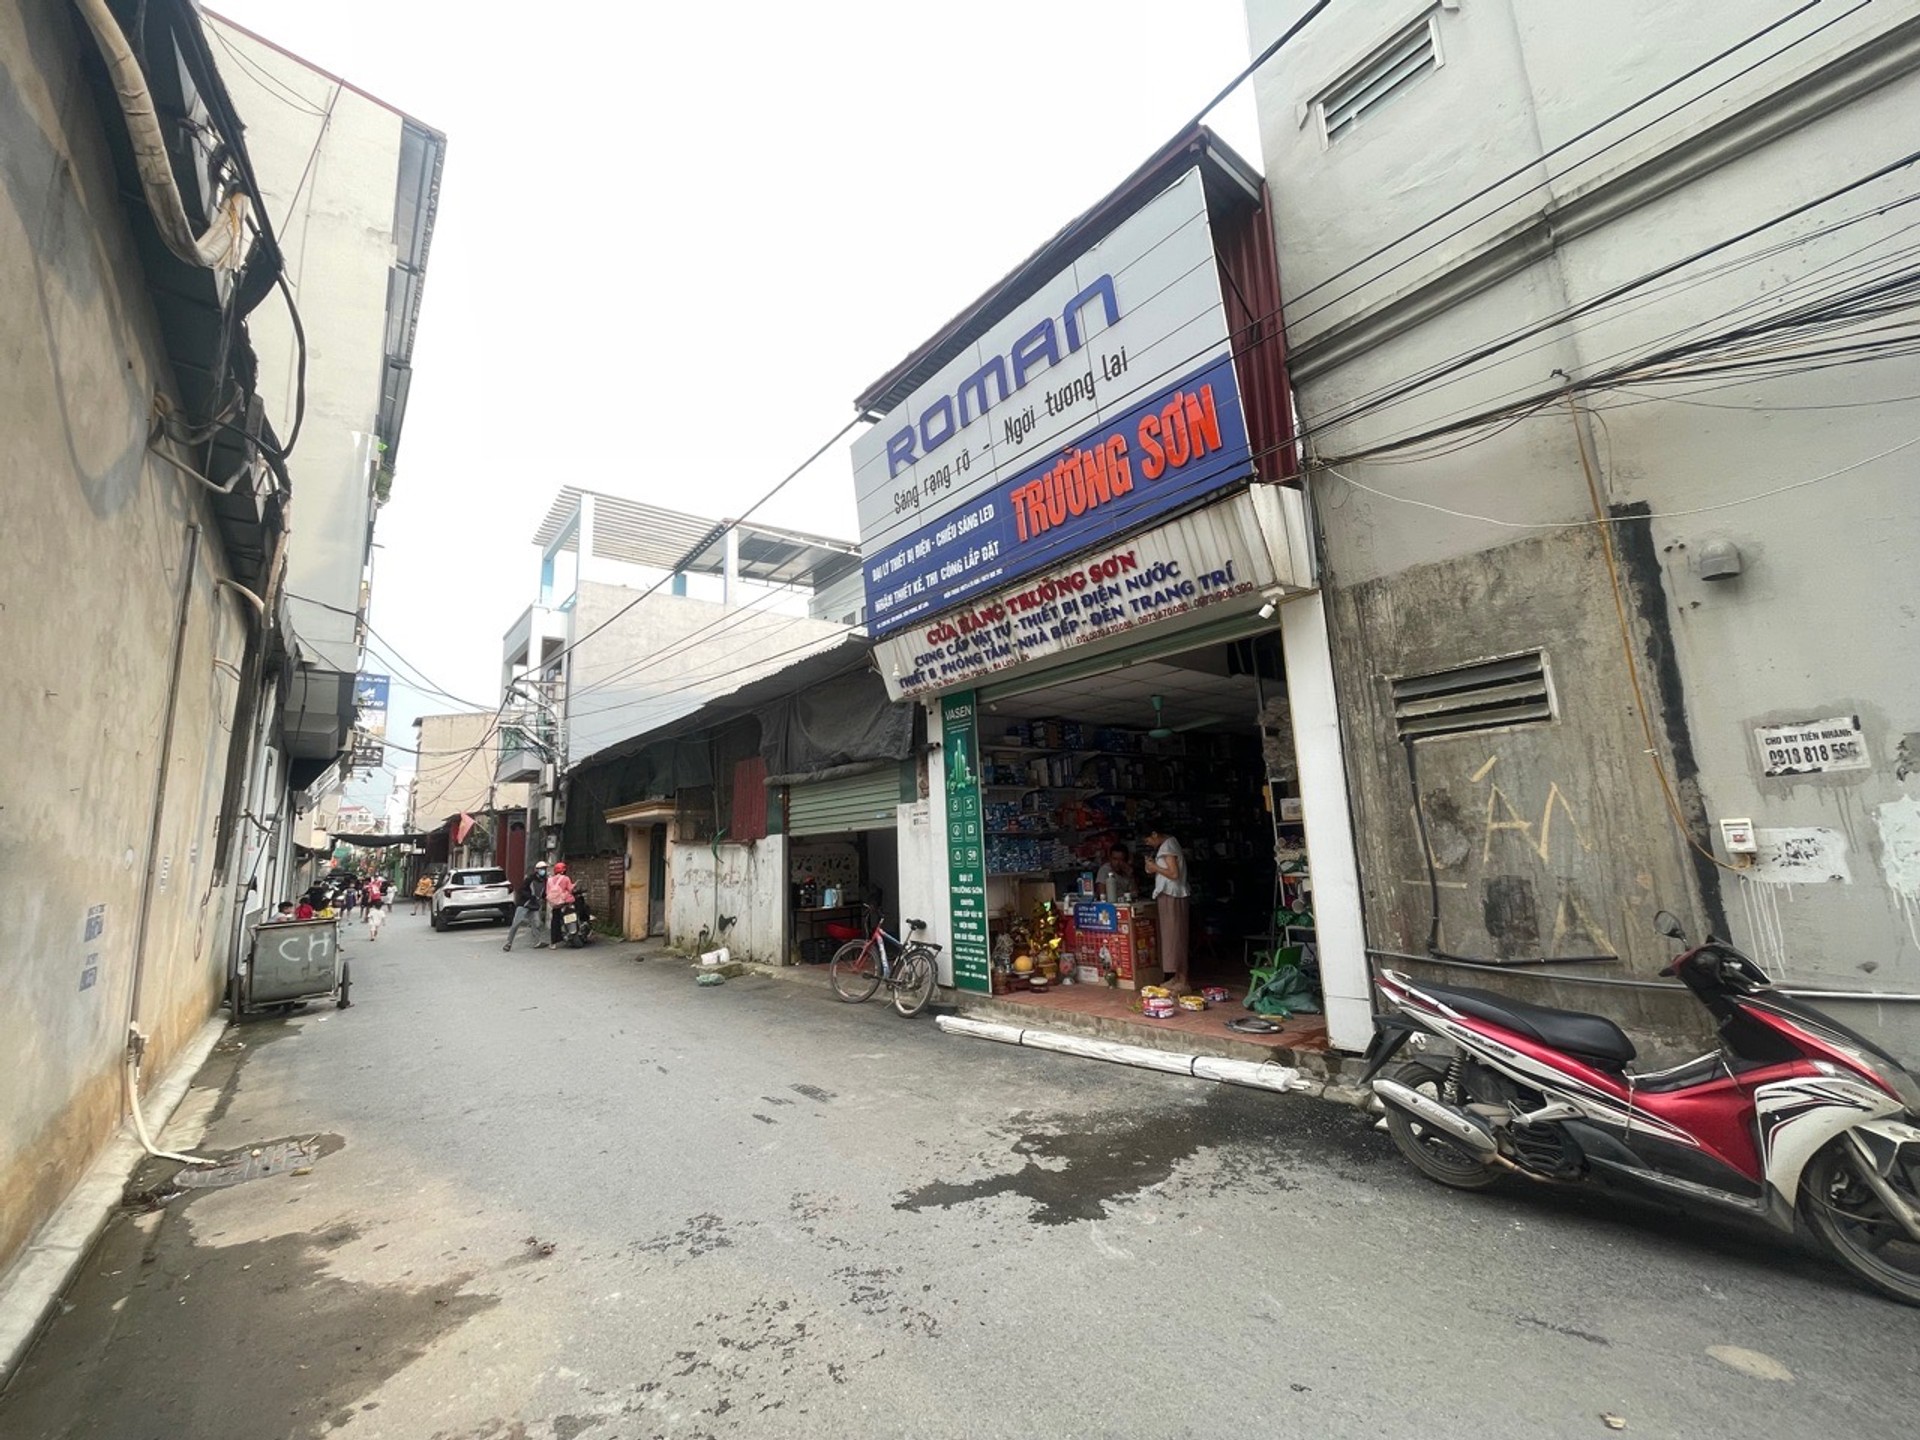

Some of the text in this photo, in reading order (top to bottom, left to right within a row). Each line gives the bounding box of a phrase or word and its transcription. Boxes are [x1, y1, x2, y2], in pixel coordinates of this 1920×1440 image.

[923, 465, 951, 496] rạng
[1004, 405, 1036, 445] Ngời
[1045, 370, 1097, 417] tương
[1102, 345, 1129, 382] lai
[1010, 383, 1223, 542] TRƯỜNG SƠN
[890, 549, 905, 573] THIẾT
[907, 547, 915, 564] BỊ
[915, 538, 931, 558] ĐIỆN
[936, 521, 957, 547] CHIẾU
[957, 511, 979, 536] SÁNG
[979, 503, 995, 525] LED
[894, 581, 912, 604] THIẾT
[925, 571, 939, 588] THI
[940, 560, 963, 580] CÔNG
[964, 547, 980, 570] LẮP
[981, 540, 999, 561] ĐẶT
[900, 667, 927, 688] THIẾT
[941, 652, 983, 675] PHÒNG
[1017, 630, 1049, 651] NHÀ
[1050, 616, 1079, 640] BẾP
[1089, 603, 1125, 627] ĐÈN
[1129, 580, 1195, 613] TRANG
[1198, 559, 1235, 592] TRÍ
[914, 648, 945, 668] CUNG
[947, 636, 970, 656] CẤP
[971, 630, 993, 648] VẬT
[993, 621, 1011, 639] TƯ
[1018, 604, 1059, 630] THIẾT
[1062, 598, 1080, 616] BỊ
[1081, 583, 1122, 609] ĐIỆN
[1125, 560, 1181, 593] NƯỚC
[926, 620, 959, 646] CỬA
[1006, 570, 1087, 616] TRƯỜNG
[1089, 550, 1138, 584] SƠN
[945, 705, 972, 720] VASEN
[1783, 735, 1798, 744] VAY
[1803, 744, 1830, 763] 818
